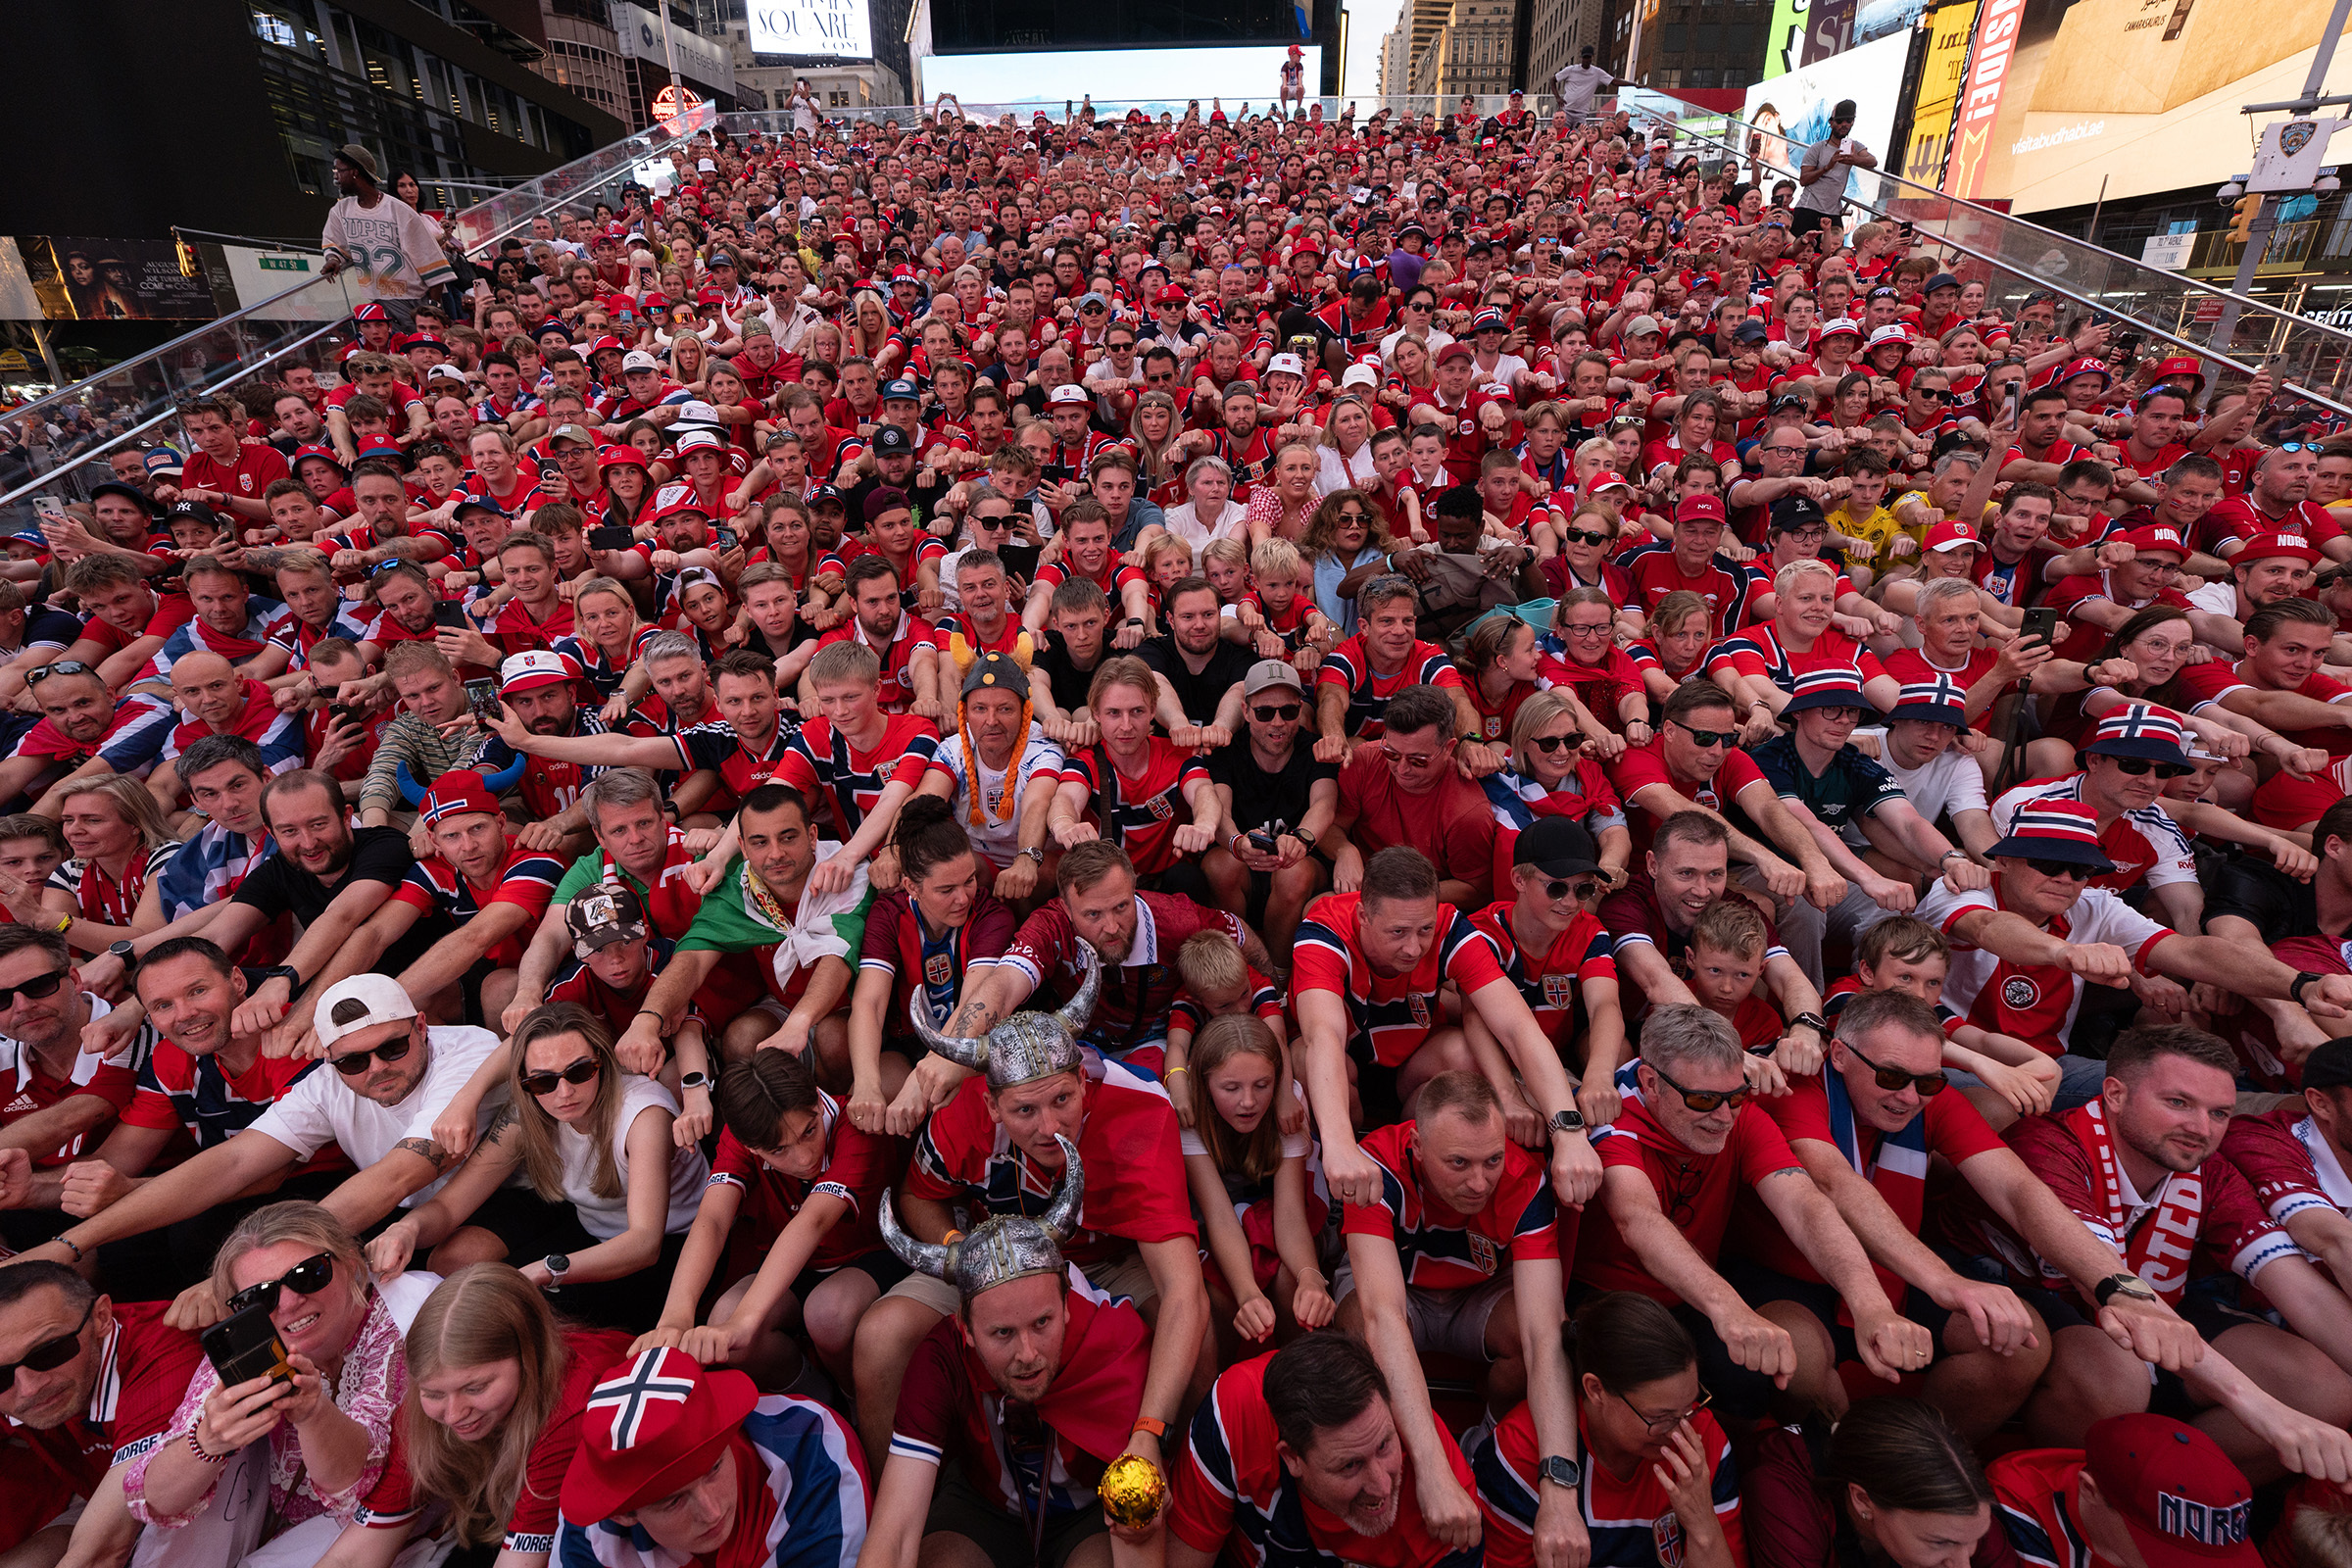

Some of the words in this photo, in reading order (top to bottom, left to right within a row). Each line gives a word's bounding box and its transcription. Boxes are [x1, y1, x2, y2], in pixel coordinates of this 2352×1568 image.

[759, 8, 857, 40] SQUARE
[2124, 14, 2168, 32] CAMARASAURUS
[690, 50, 728, 76] REGENCY
[2012, 120, 2105, 156] visitabudhabi.ae
[2318, 167, 2337, 175] NYPD
[2168, 235, 2183, 246] AVENUE
[269, 260, 276, 270] W
[278, 260, 287, 270] 47
[289, 260, 298, 270] St
[139, 281, 166, 291] COME
[173, 281, 199, 291] GONE
[896, 275, 919, 285] NORW
[2304, 310, 2352, 326] CENT
[175, 502, 191, 512] NY
[548, 761, 569, 771] adida
[3, 1102, 39, 1113] adidas
[813, 1182, 845, 1198] NORGE
[112, 1435, 160, 1466] NORGE
[2157, 1490, 2253, 1547] NORG
[513, 1534, 555, 1553] NORGE
